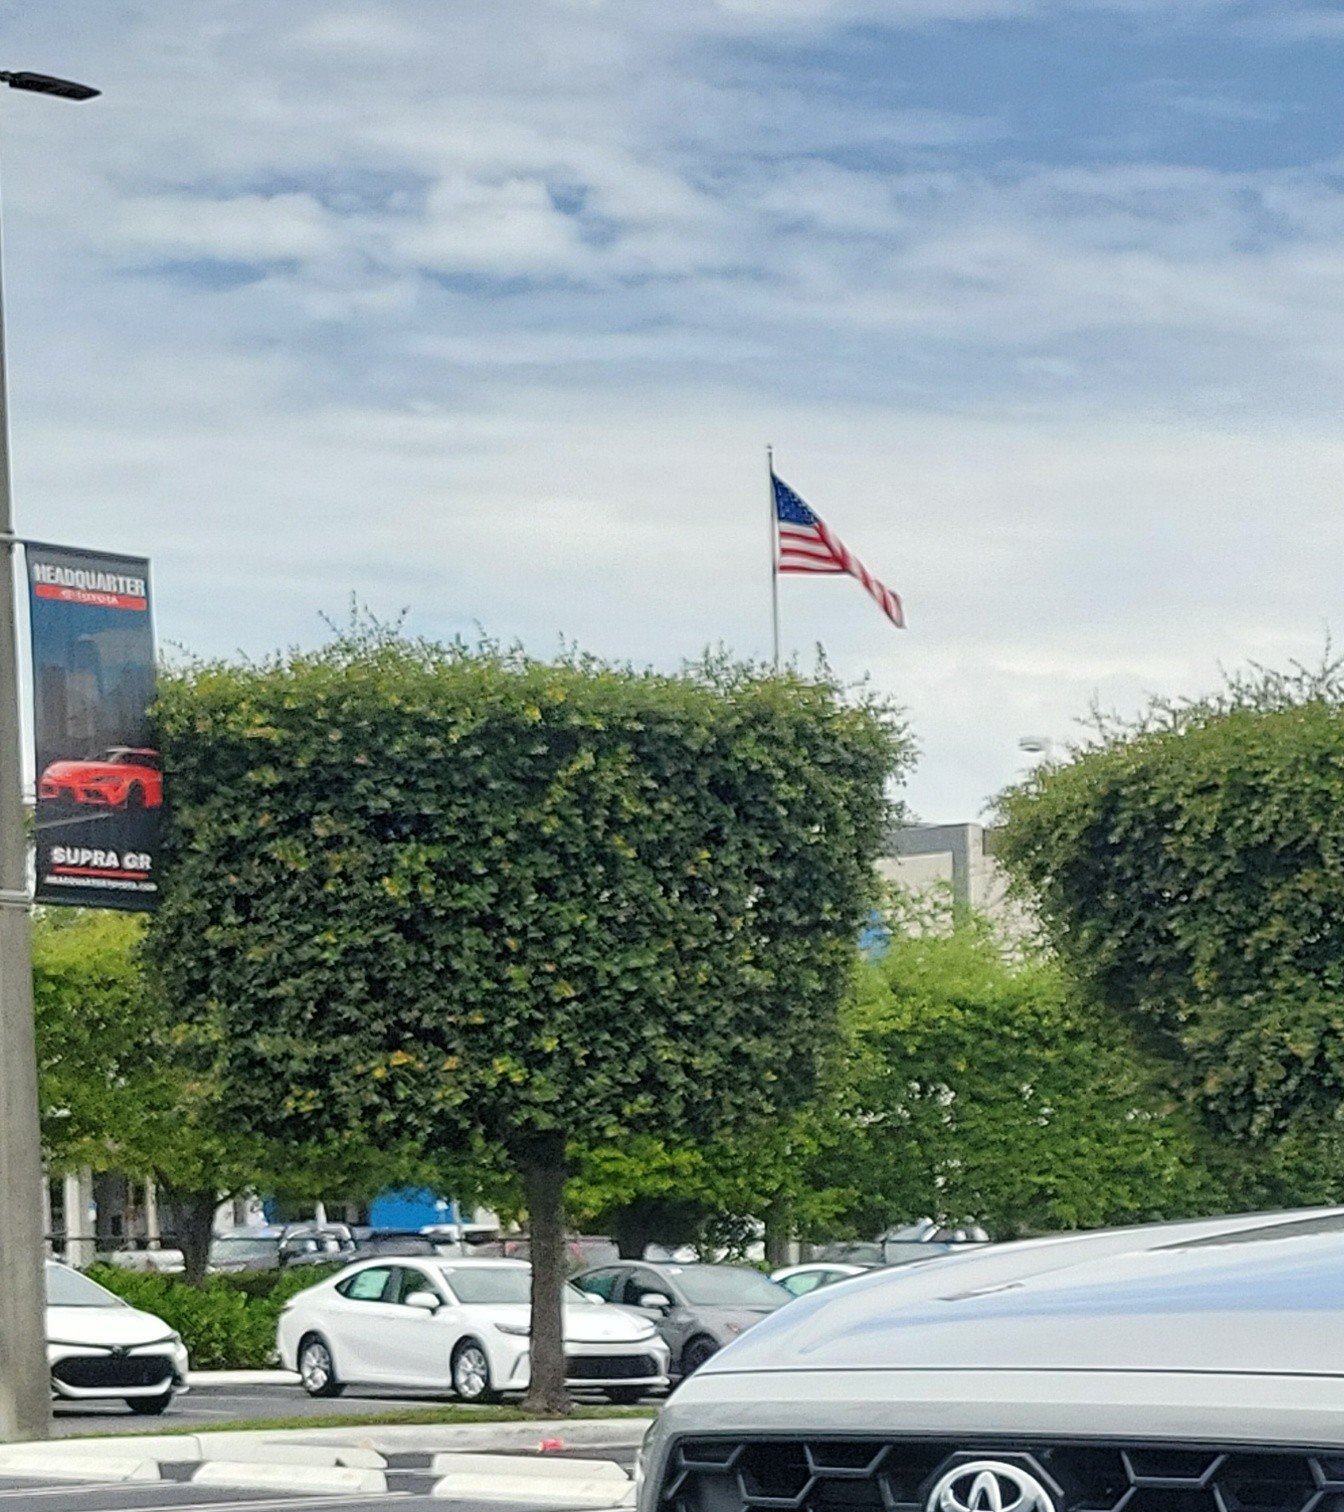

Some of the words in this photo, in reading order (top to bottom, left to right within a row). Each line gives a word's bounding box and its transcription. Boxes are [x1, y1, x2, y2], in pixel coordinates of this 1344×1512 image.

[33, 562, 146, 598] HEADQUARTER
[51, 845, 120, 869] SUPRA
[122, 851, 153, 871] GR
